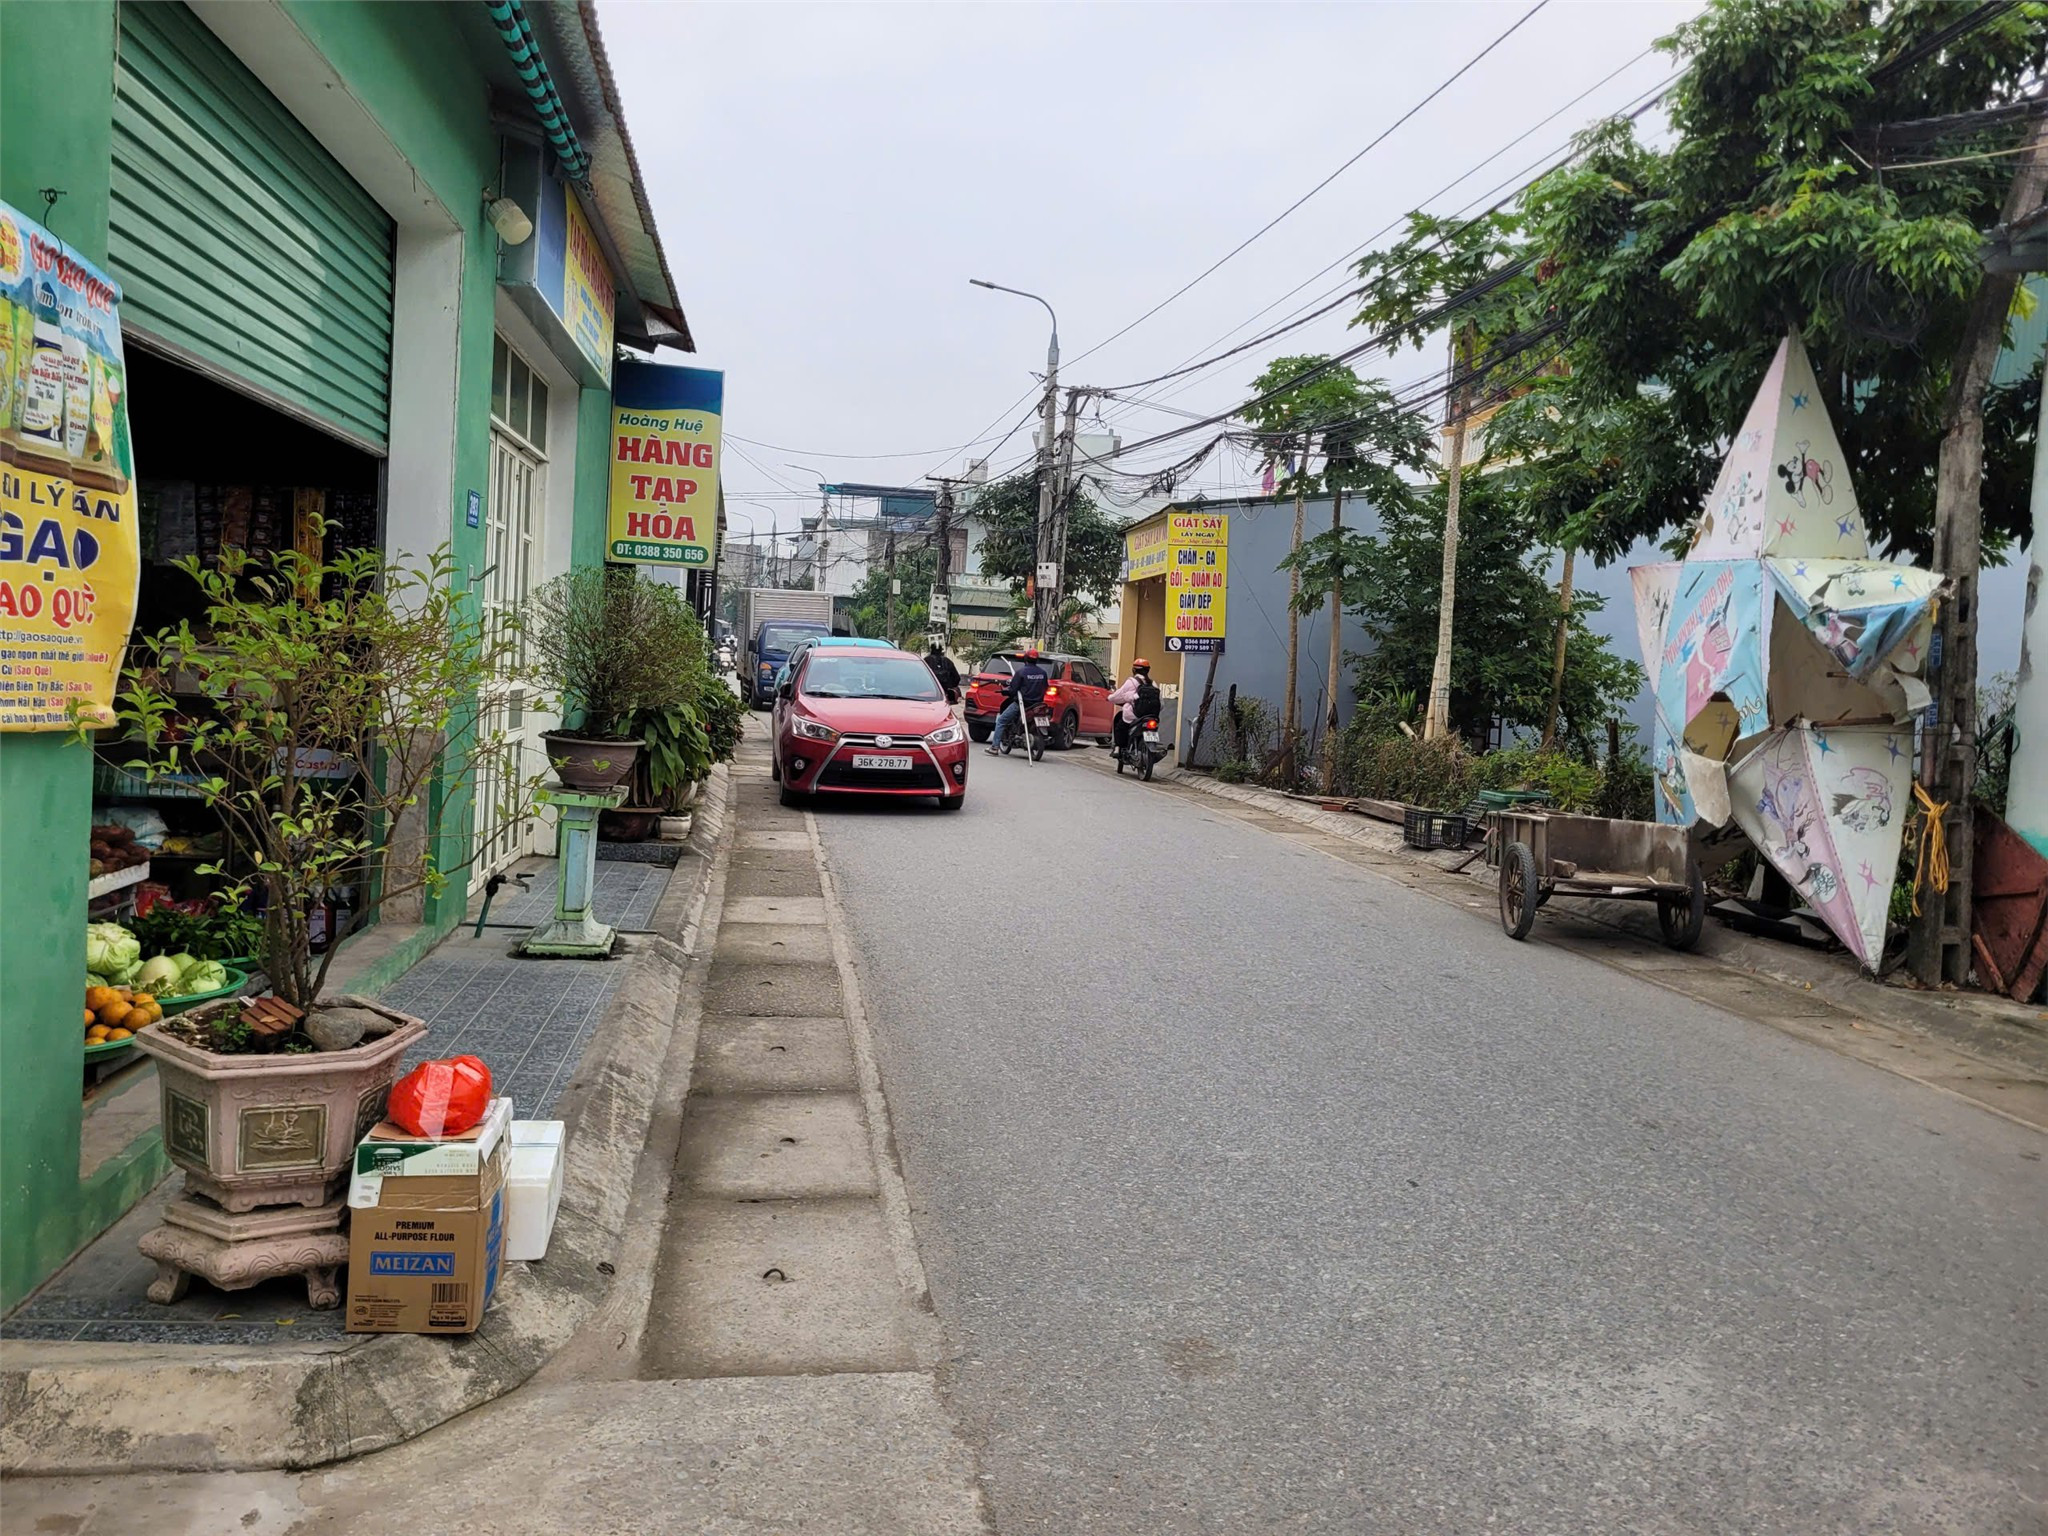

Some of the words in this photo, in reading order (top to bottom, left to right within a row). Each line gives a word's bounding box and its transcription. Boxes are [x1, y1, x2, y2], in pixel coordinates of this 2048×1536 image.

[619, 413, 669, 432] Hoàng
[674, 418, 704, 435] Huệ
[617, 434, 713, 469] HÀNG
[30, 480, 66, 507] LÝ
[630, 475, 698, 506] TẠP
[627, 509, 696, 541] HÓA
[616, 543, 632, 555] ĐT:
[634, 544, 660, 558] 0388
[663, 546, 682, 559] 350
[684, 547, 704, 561] 656
[1206, 550, 1216, 566] GA
[1198, 591, 1212, 609] DÉP
[1193, 614, 1213, 631] BÔNG
[857, 757, 908, 768] 36K-278.77
[396, 1221, 435, 1230] PREMIUM
[374, 1232, 428, 1241] ALL-PURPOSE
[430, 1233, 455, 1242] FLOUR
[375, 1257, 451, 1272] MEIZAN
